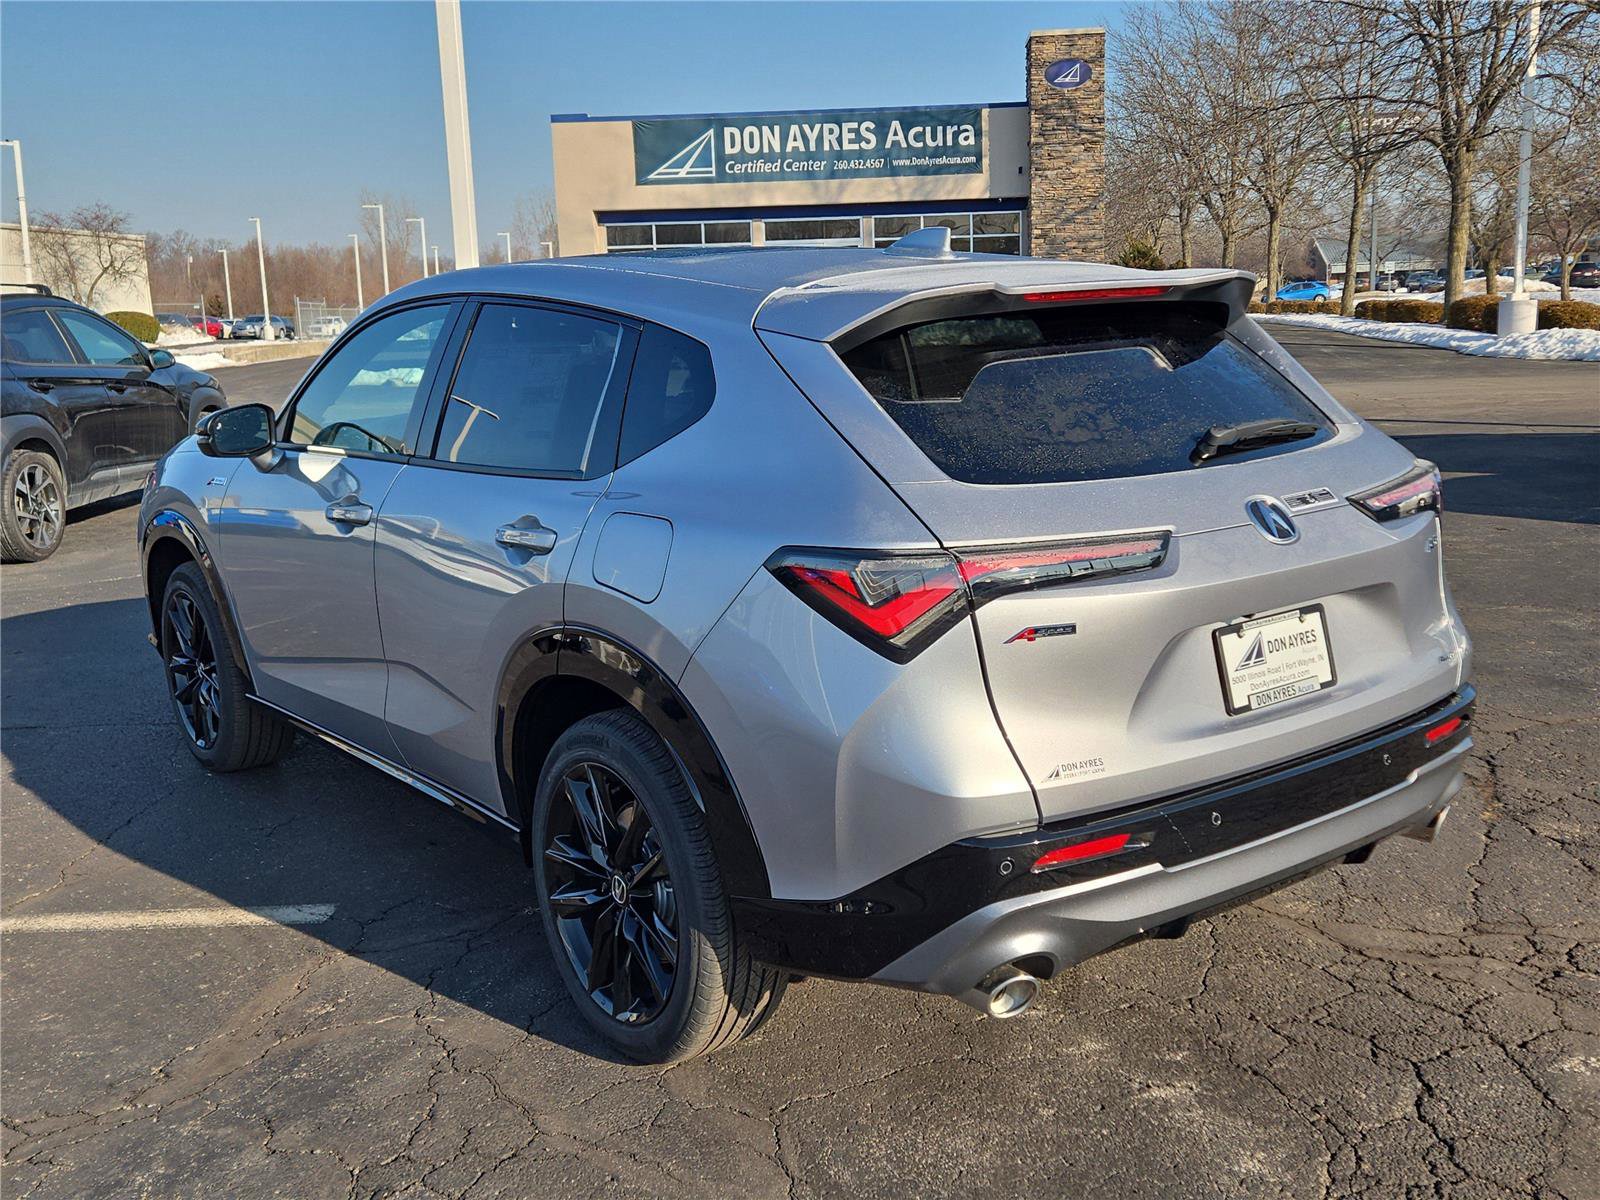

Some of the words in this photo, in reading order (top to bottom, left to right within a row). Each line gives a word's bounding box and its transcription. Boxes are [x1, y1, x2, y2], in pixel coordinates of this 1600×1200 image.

[723, 125, 780, 154] DON
[785, 122, 877, 152] AYRES
[885, 120, 976, 149] Acura
[725, 159, 780, 173] Certified
[783, 159, 827, 171] Center
[833, 158, 884, 170] 260.432.4567
[892, 155, 977, 167] www.DonAyresAcura.com
[1267, 637, 1288, 654] DON
[1288, 629, 1317, 649] AYRES
[1256, 691, 1273, 706] DON
[1273, 684, 1297, 700] AYRES
[1061, 761, 1078, 772] DON
[1079, 757, 1104, 769] AYRES
